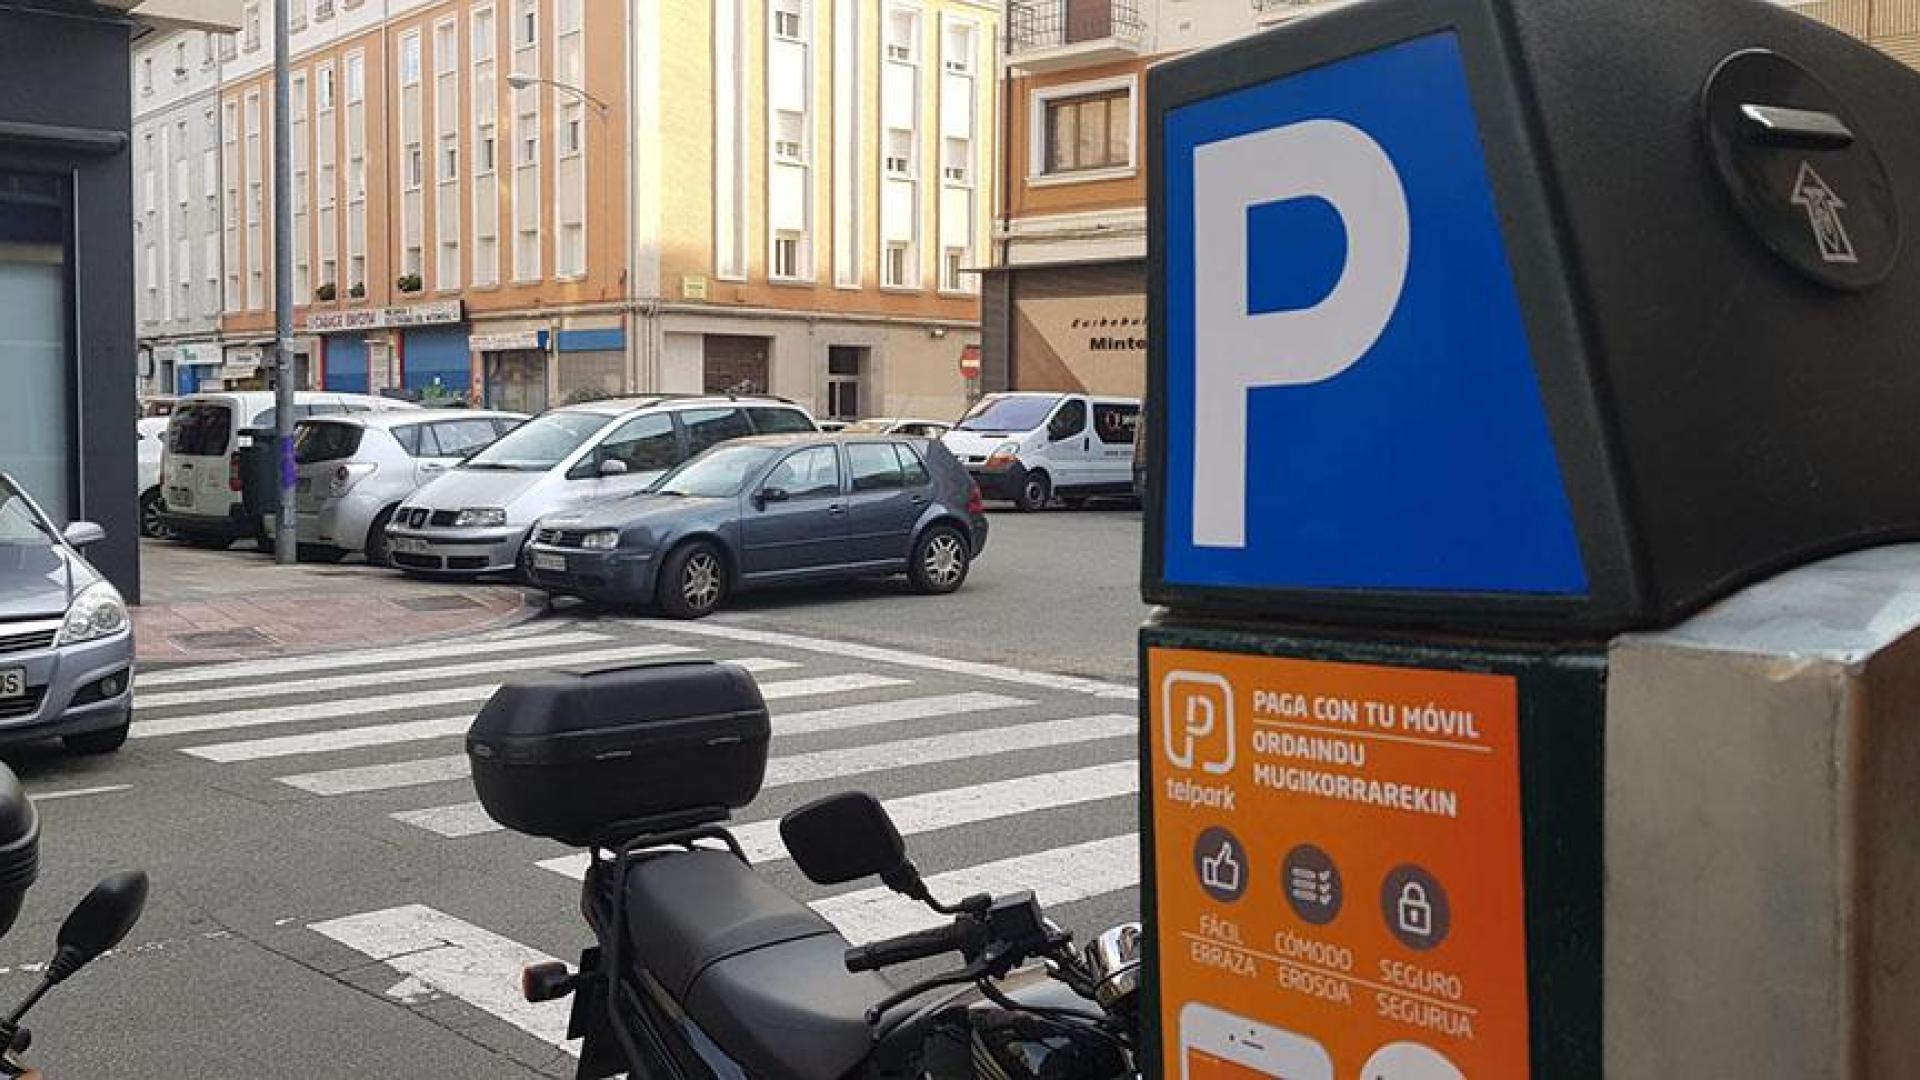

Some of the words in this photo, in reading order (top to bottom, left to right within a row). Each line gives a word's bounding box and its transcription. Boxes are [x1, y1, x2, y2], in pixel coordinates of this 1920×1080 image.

[1193, 119, 1411, 548] P
[1254, 690, 1308, 718] PAGA
[1312, 697, 1358, 724] CON
[1365, 701, 1395, 728] TU
[1402, 703, 1481, 739] MÓVIL
[1252, 730, 1366, 768] ORDAINDU
[1165, 778, 1236, 812] telpark
[1254, 763, 1457, 818] MUGIKORRAREKIN
[1199, 913, 1244, 945] FÁCIL
[1190, 943, 1257, 978] ERRAZA
[1274, 929, 1353, 971] CÓMODO
[1278, 968, 1351, 1005] EROSOA
[1379, 958, 1462, 1001] SEGURO
